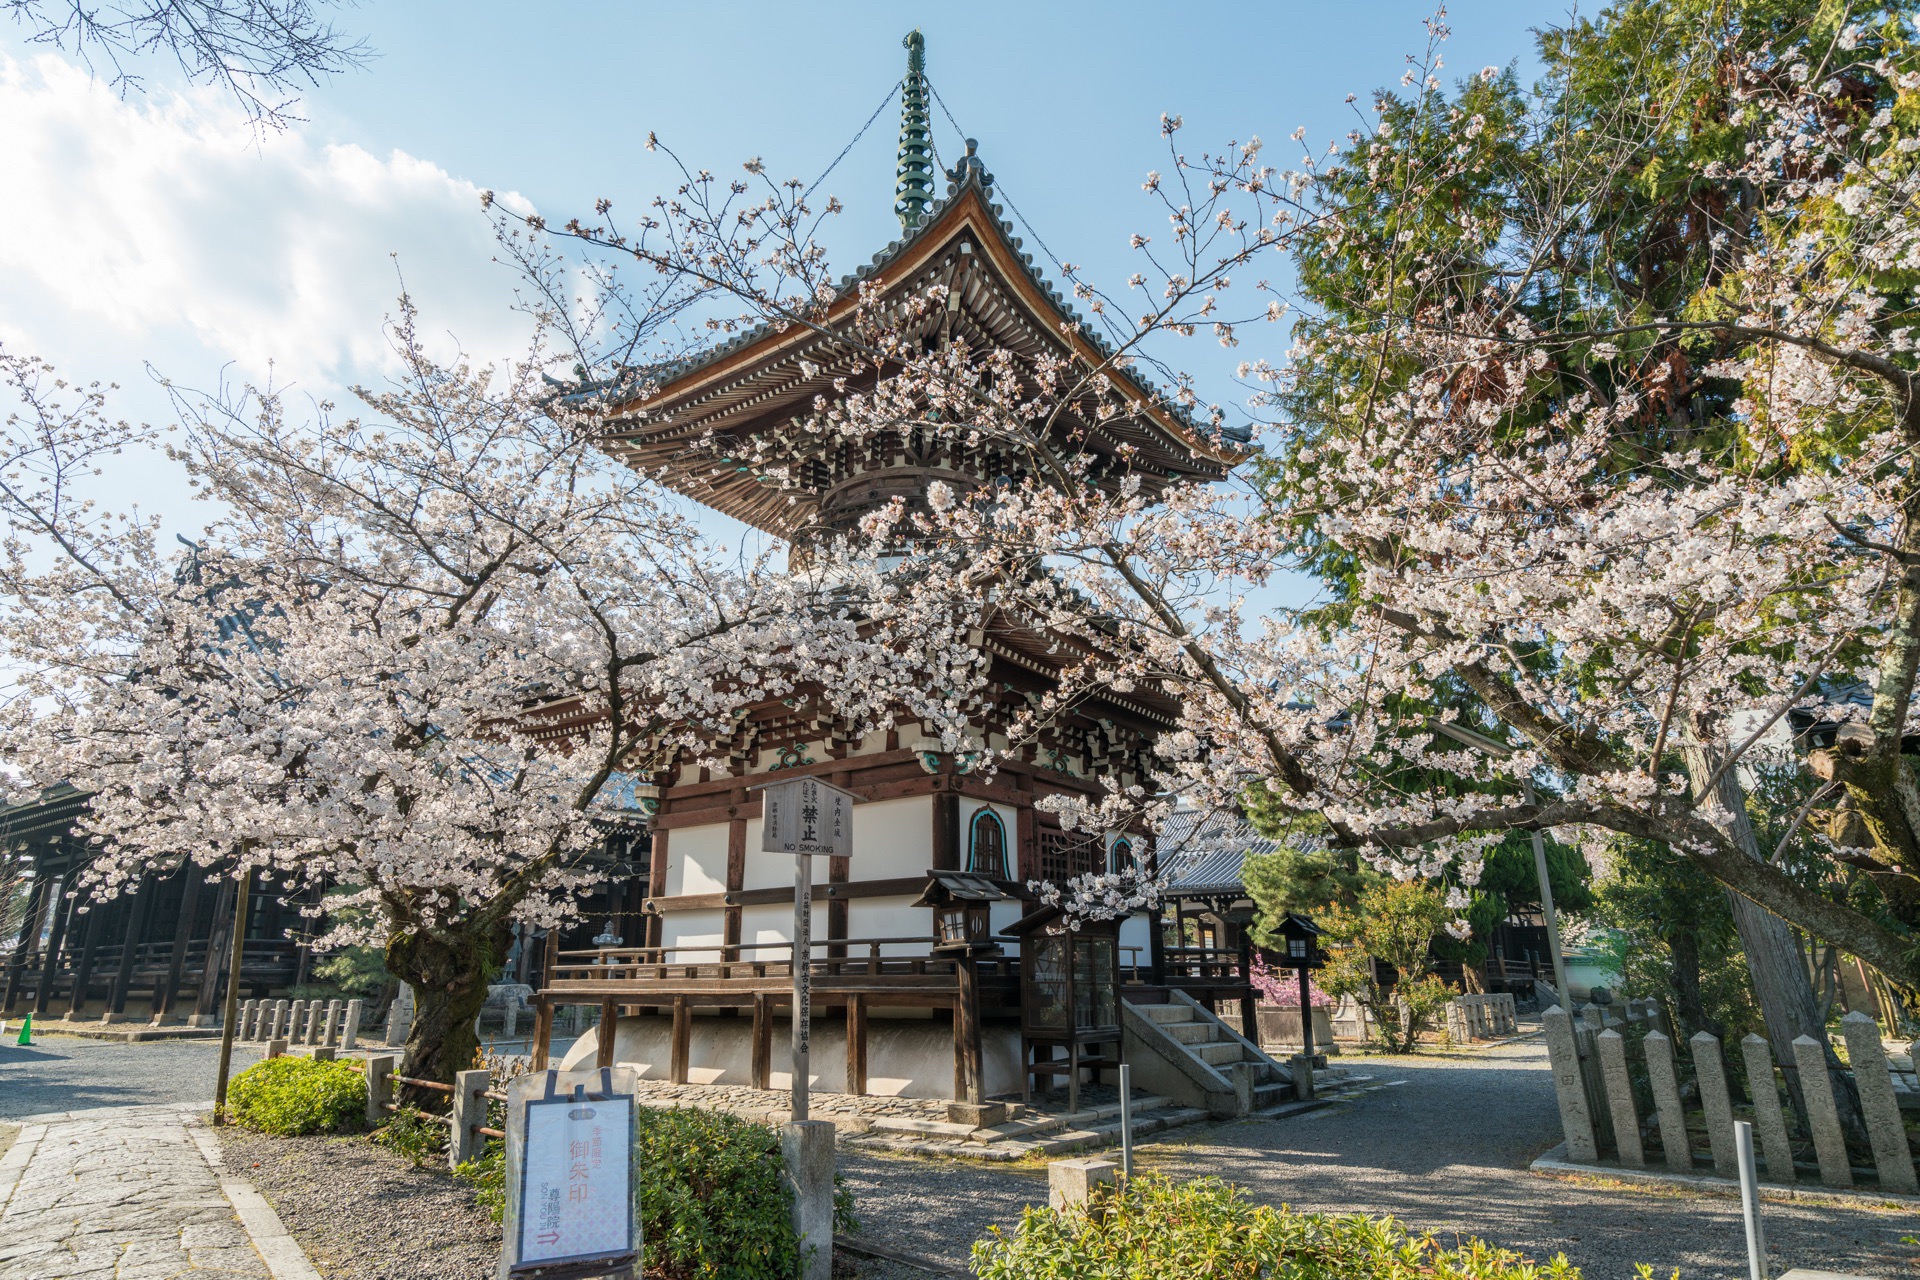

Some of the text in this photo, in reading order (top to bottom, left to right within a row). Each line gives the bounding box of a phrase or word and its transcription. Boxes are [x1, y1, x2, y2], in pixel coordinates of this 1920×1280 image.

[801, 805, 819, 842] 禁止
[784, 843, 834, 853] NO SMOKING
[591, 1125, 603, 1170] 季節限定
[569, 1140, 590, 1203] 御朱印
[539, 1182, 549, 1230] SON YOU IN
[547, 1188, 561, 1229] 尊陽院
